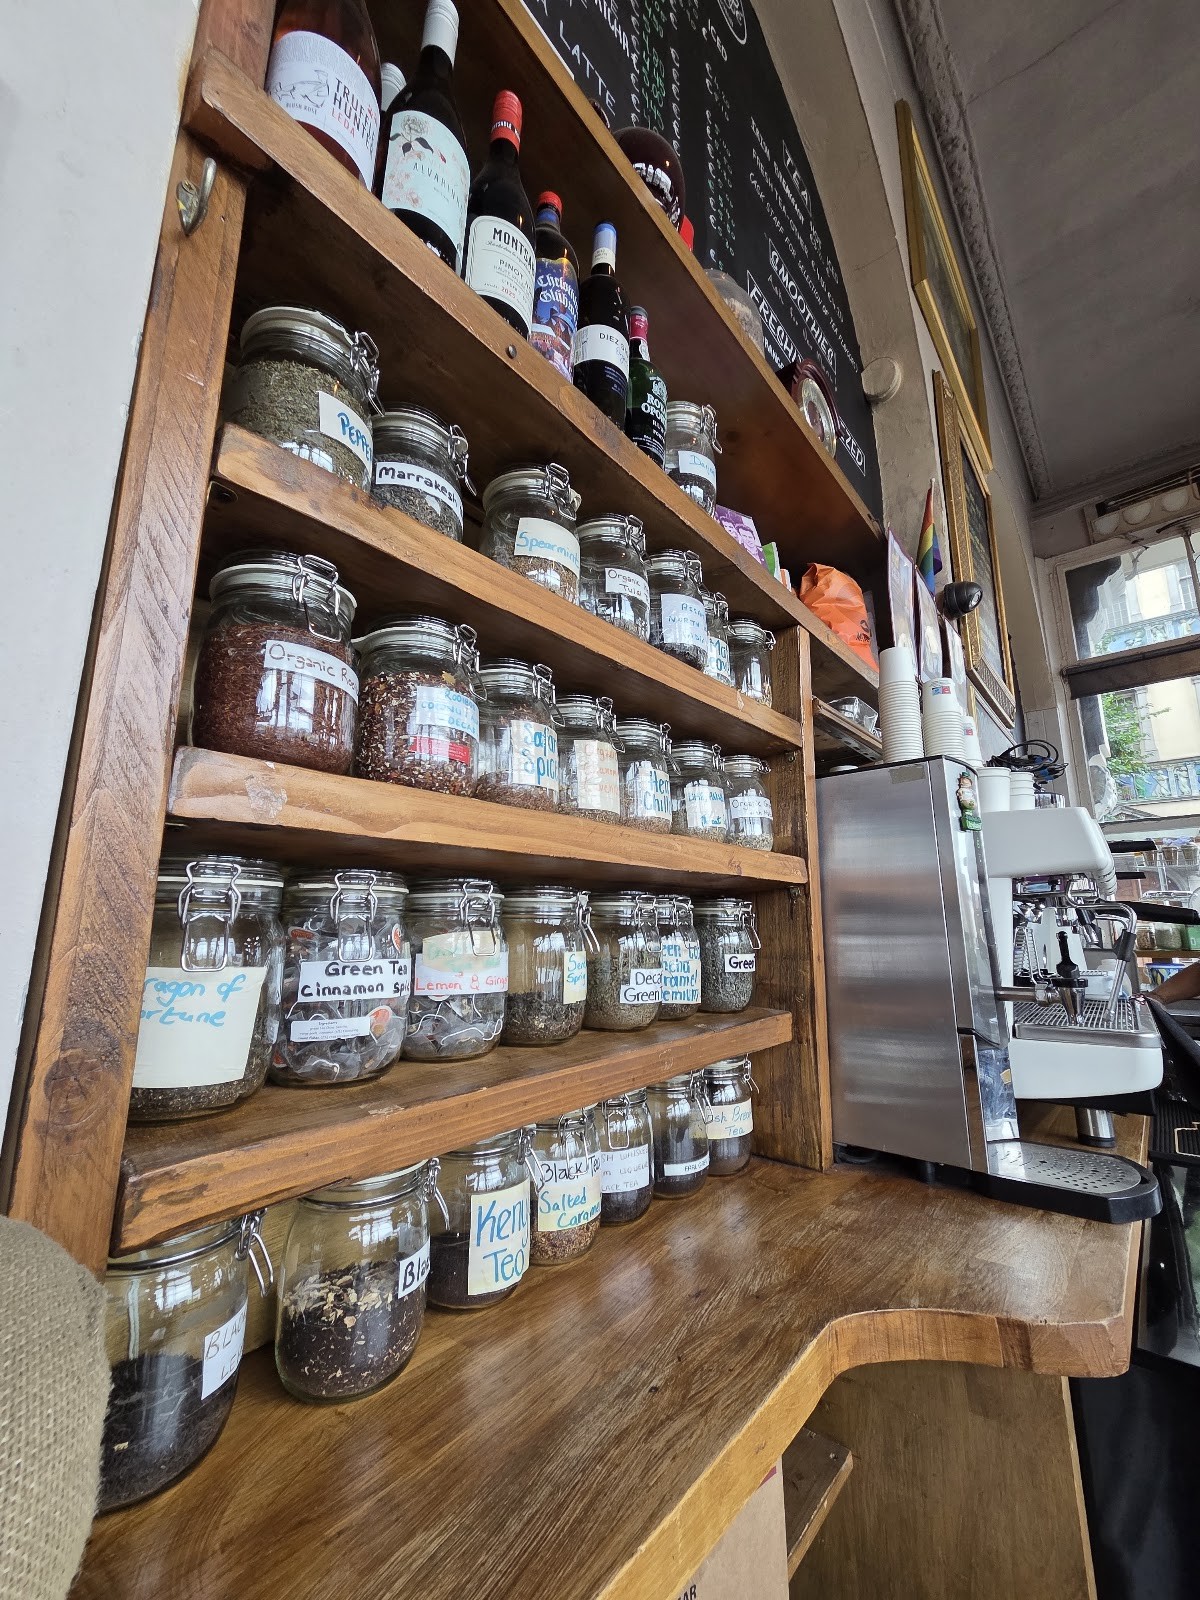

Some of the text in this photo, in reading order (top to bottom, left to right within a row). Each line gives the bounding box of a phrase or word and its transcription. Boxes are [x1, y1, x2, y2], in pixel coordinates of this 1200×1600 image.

[708, 18, 728, 62] ICED
[559, 19, 616, 117] LATTE
[331, 107, 355, 138] LEDA
[784, 146, 808, 207] TEA
[784, 236, 797, 259] FOR
[499, 258, 524, 279] PINOT
[770, 250, 834, 367] SMOOTHIES
[599, 331, 619, 346] DIEZ
[378, 465, 457, 508] Marrakesh
[516, 531, 580, 569] Spearmint
[607, 569, 641, 587] Organic
[269, 643, 336, 678] Organic
[324, 960, 408, 976] Green Tea
[635, 971, 662, 986] Deca
[144, 973, 247, 1008] ragon of
[415, 977, 462, 991] Lemon
[469, 974, 480, 991] &
[623, 987, 660, 1002] Green
[140, 1006, 227, 1027] ortune
[724, 1124, 746, 1136] Tea
[540, 1158, 584, 1184] Black
[601, 1179, 639, 1192] LACK TEA
[539, 1186, 588, 1215] Salted
[476, 1199, 529, 1249] Keny
